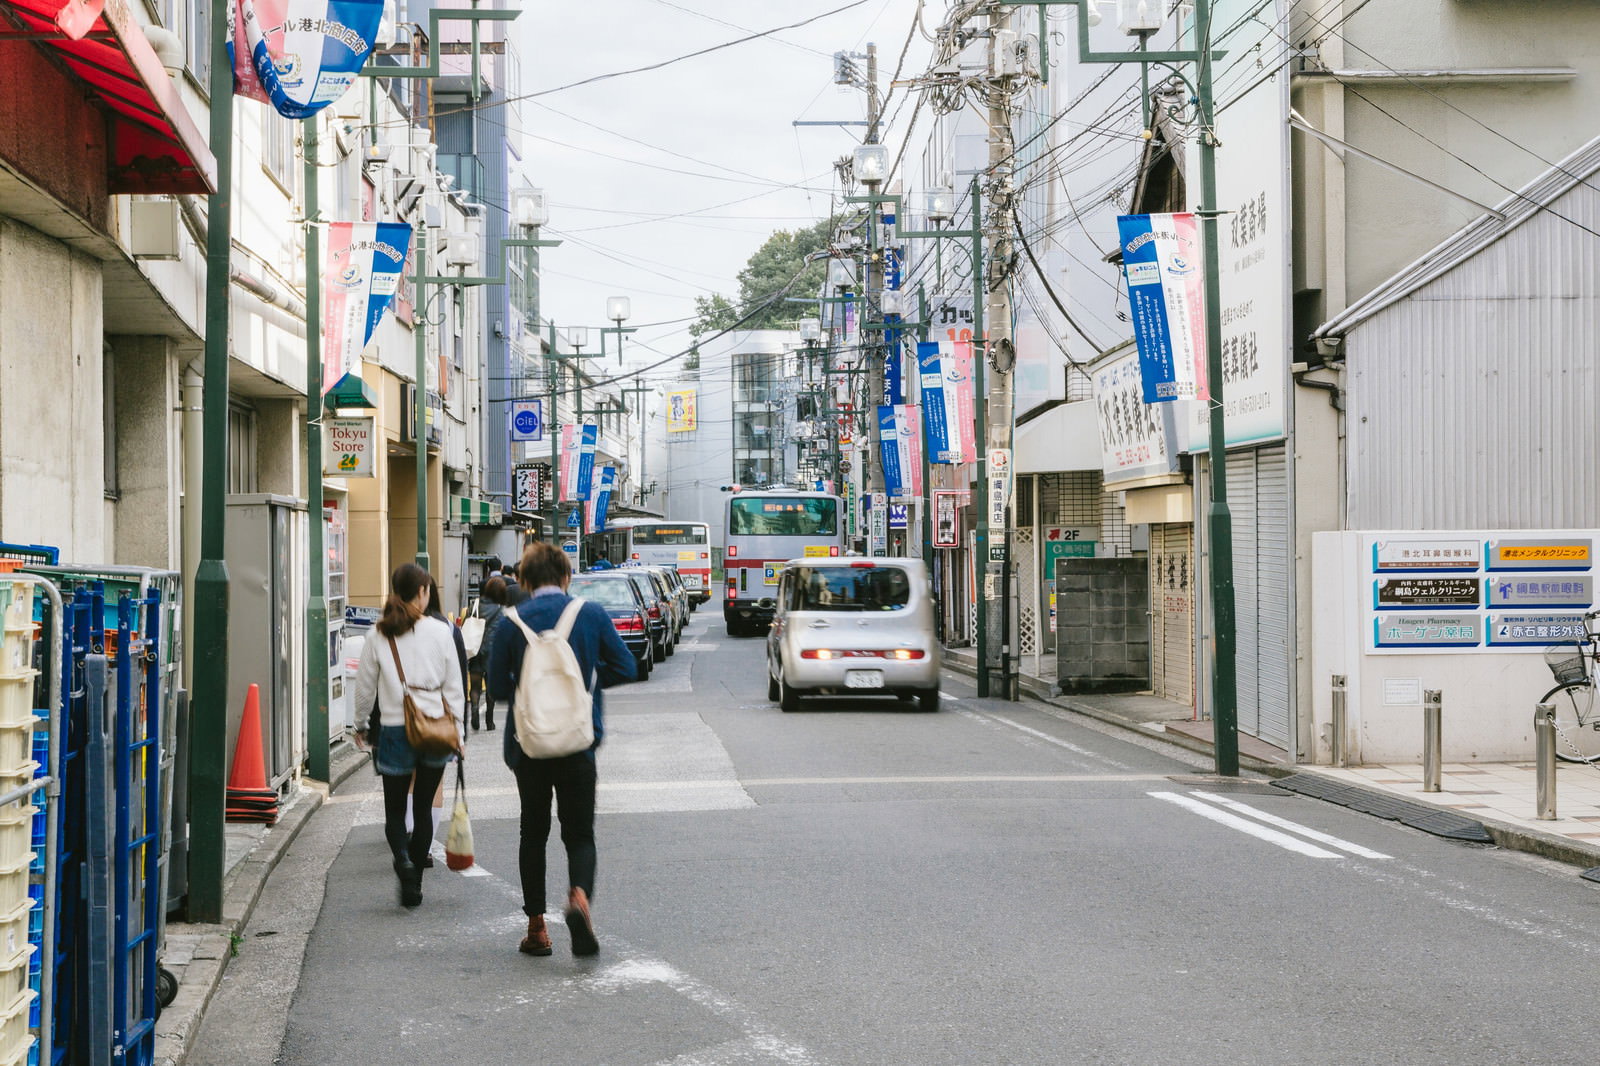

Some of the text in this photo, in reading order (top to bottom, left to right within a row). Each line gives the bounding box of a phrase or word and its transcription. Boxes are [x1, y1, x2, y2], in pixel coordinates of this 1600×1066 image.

[330, 427, 367, 441] Tokyu
[332, 441, 364, 452] Store
[341, 454, 356, 466] 24
[518, 470, 528, 509] ラーメン
[1064, 530, 1080, 541] 2F
[1503, 549, 1586, 557] 港北メンタルクリニック
[1394, 586, 1476, 596] 綱島ウェルクリニック
[1387, 625, 1473, 639] ホーゲン薬局
[1512, 625, 1586, 638] 赤石整形外科
